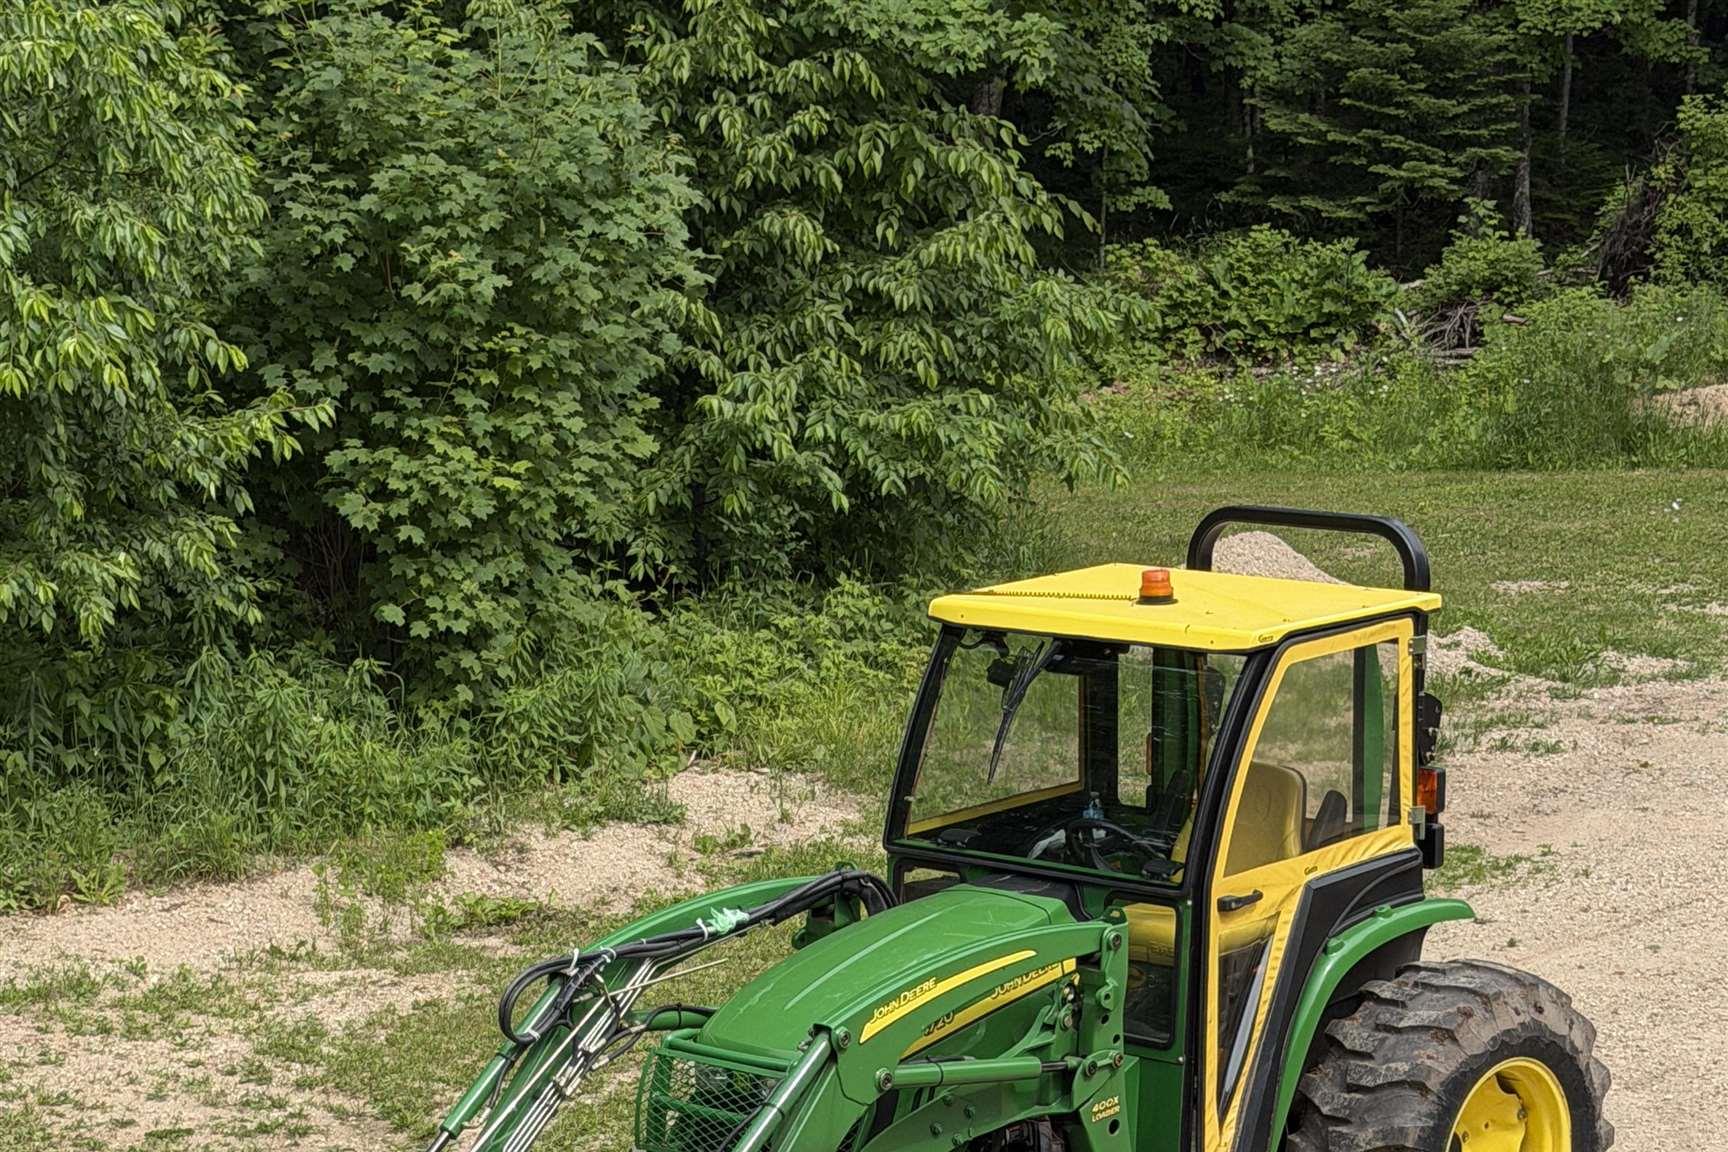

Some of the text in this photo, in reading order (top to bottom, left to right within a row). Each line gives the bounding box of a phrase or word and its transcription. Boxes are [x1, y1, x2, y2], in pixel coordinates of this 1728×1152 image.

[990, 962, 1060, 999] JOHN DEE
[869, 976, 937, 1024] JOHN DEERE
[924, 1011, 953, 1036] 20
[1092, 1095, 1119, 1113] 400X
